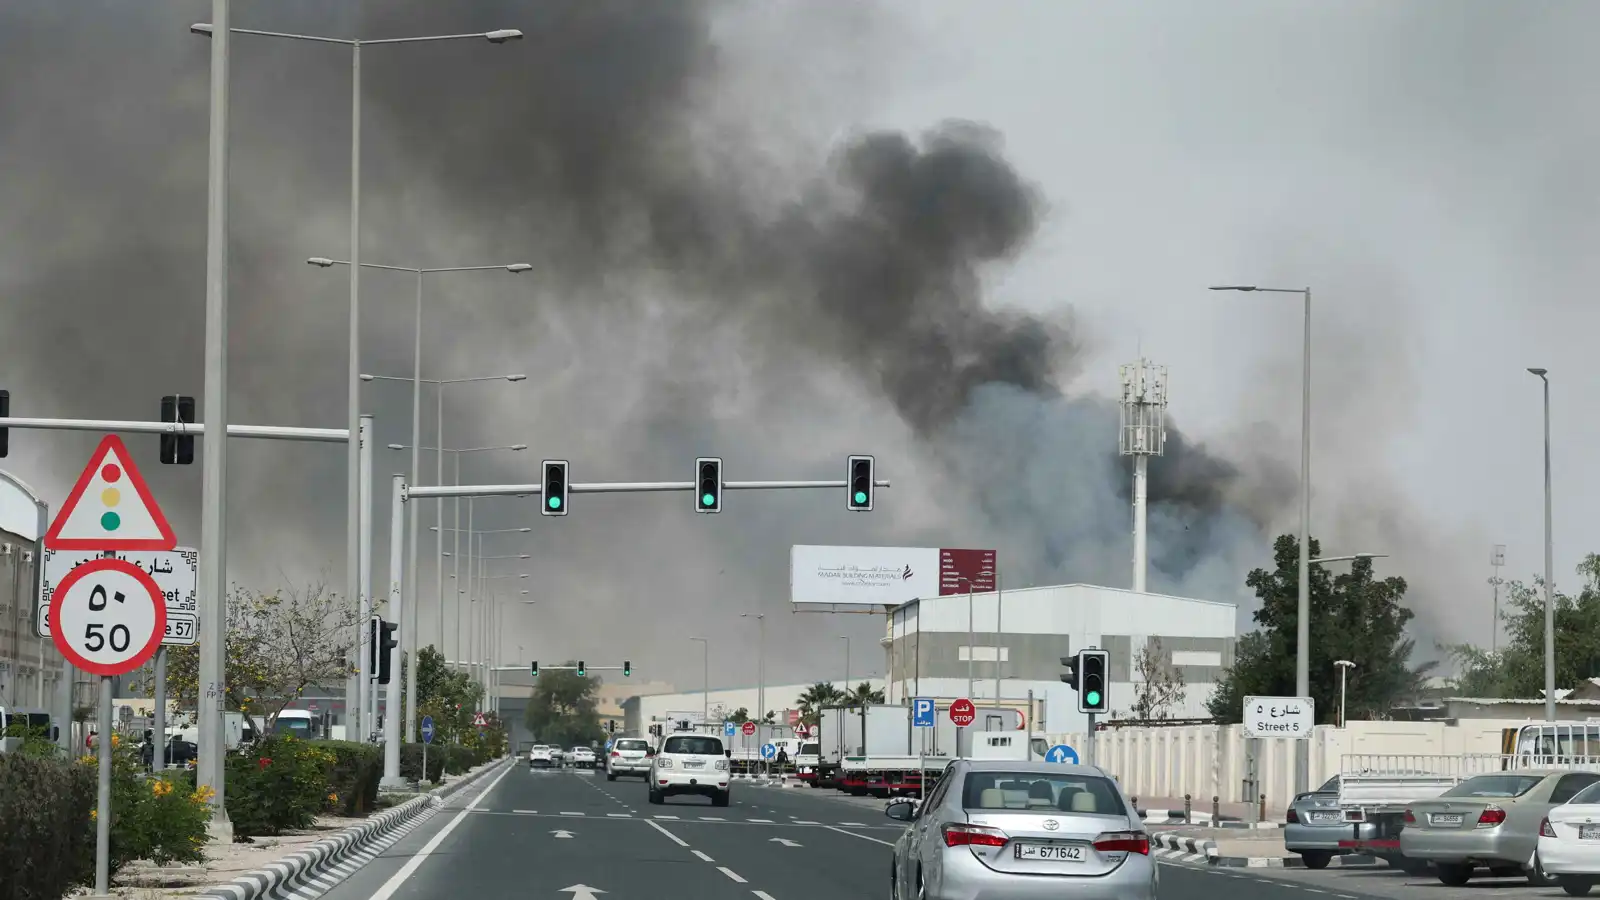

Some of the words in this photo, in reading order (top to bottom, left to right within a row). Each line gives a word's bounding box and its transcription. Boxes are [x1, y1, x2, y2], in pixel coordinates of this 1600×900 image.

[176, 622, 191, 636] 57
[84, 623, 131, 652] 50
[917, 701, 930, 718] P
[1271, 705, 1300, 717] شارع
[726, 722, 733, 732] P
[1257, 722, 1290, 731] Street
[1293, 722, 1299, 731] 5
[1023, 847, 1036, 856] قطر
[1040, 846, 1080, 859] 671642
